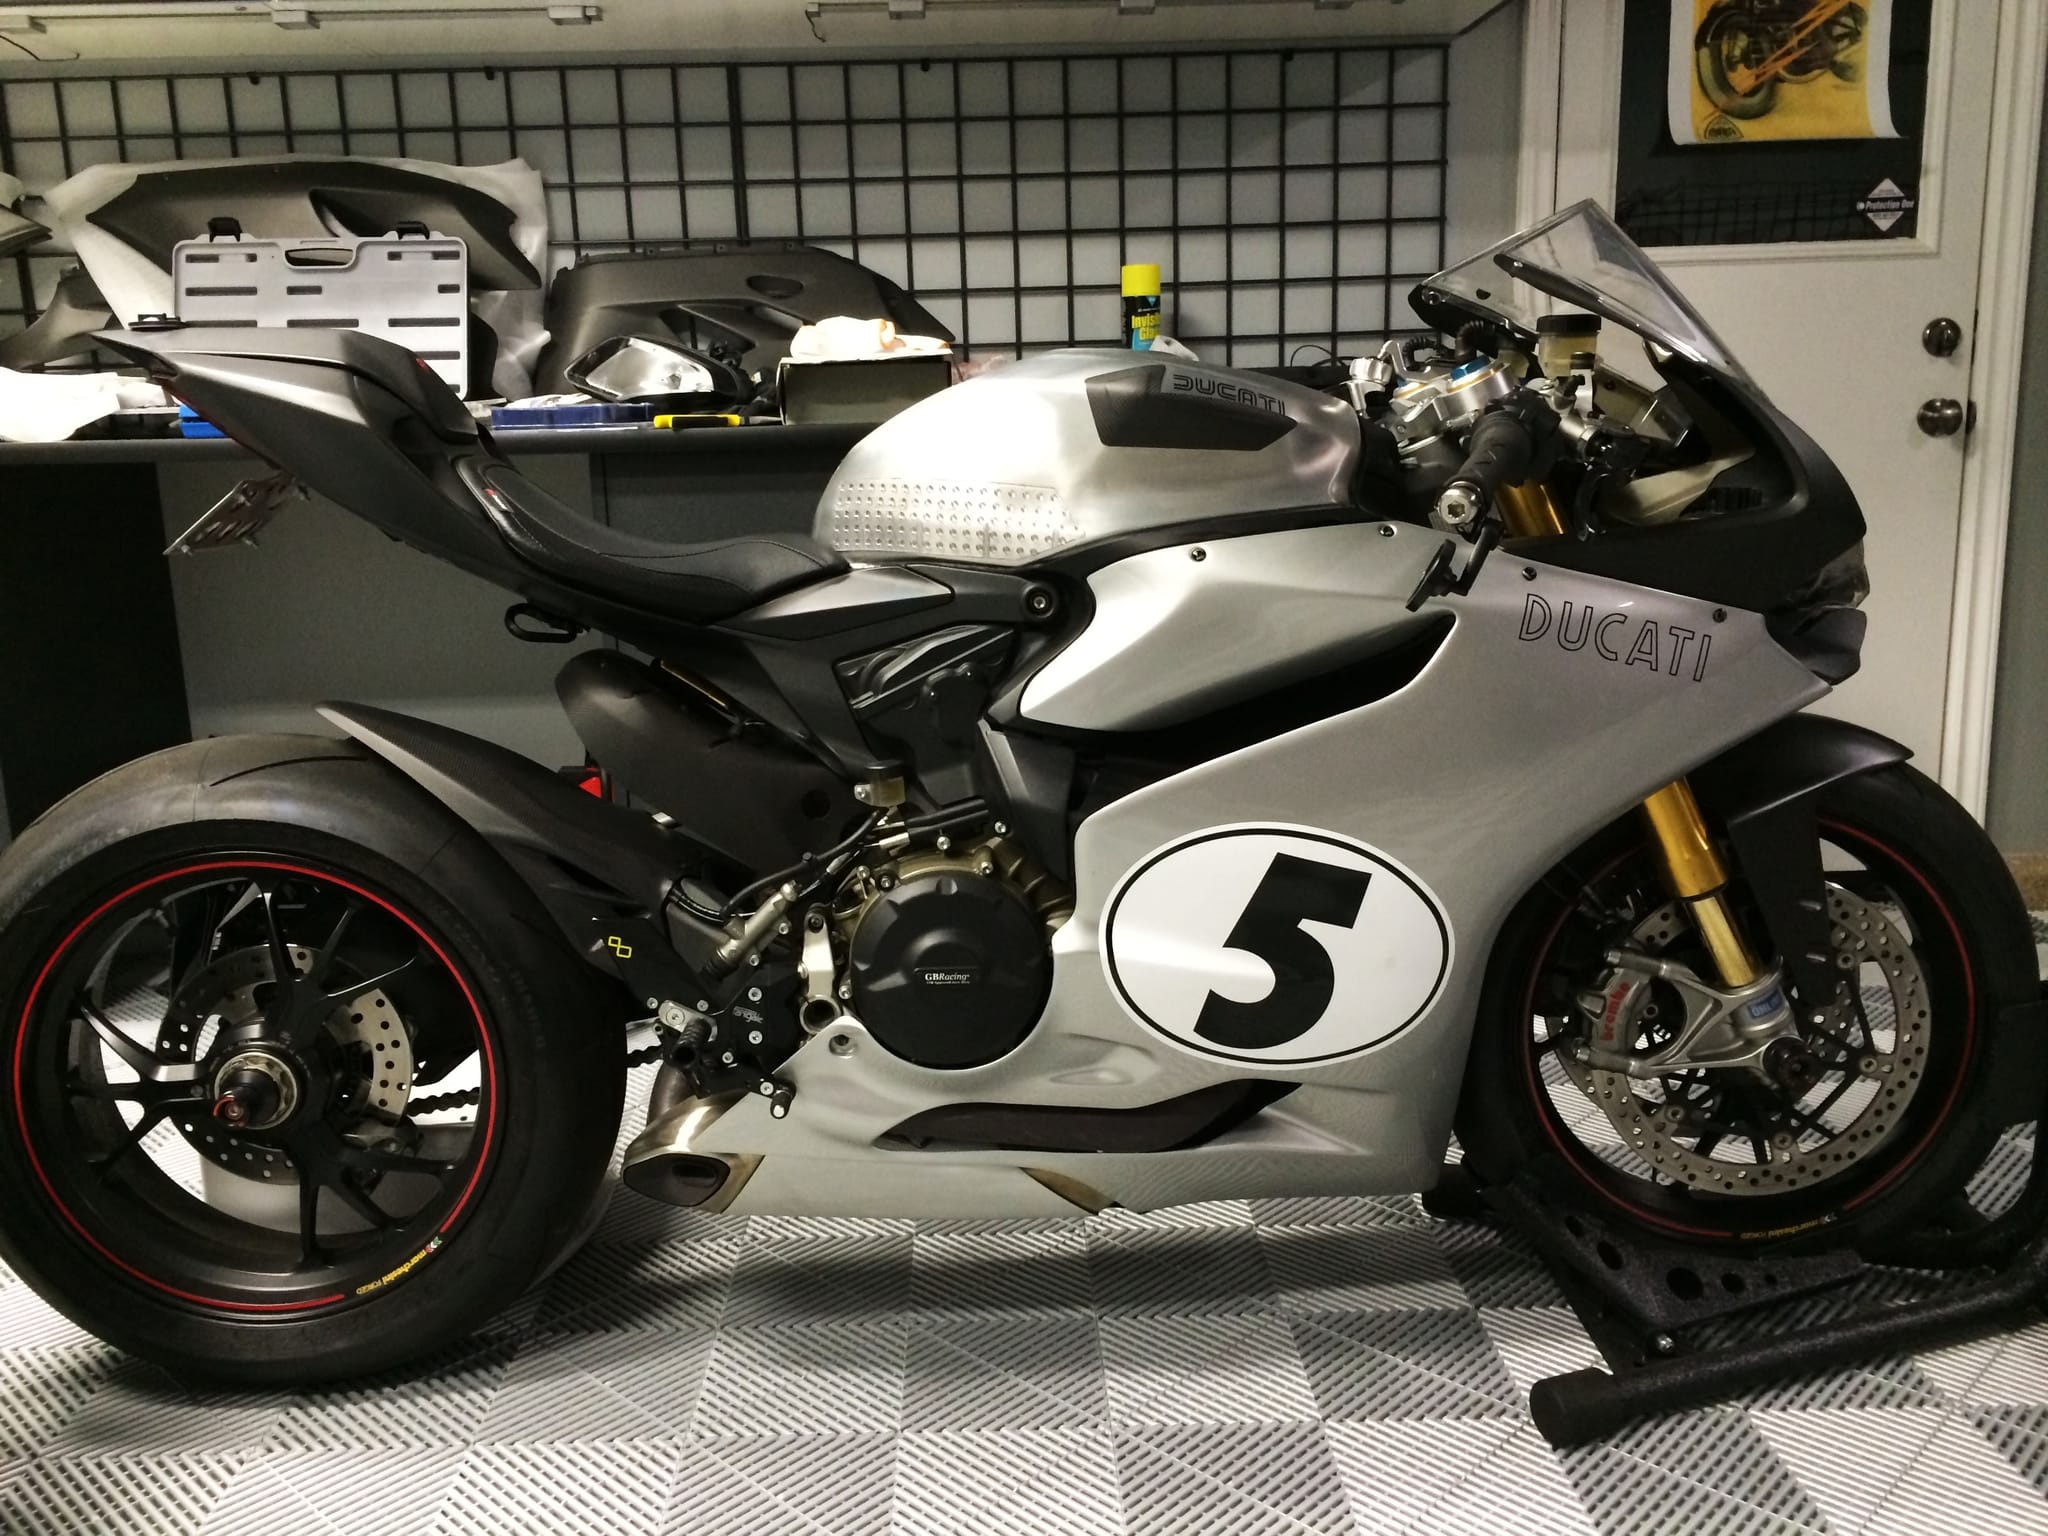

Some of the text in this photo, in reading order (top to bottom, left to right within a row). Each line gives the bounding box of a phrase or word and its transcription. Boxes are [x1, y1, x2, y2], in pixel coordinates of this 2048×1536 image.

[1173, 374, 1286, 416] DUCATI
[1519, 593, 1712, 682] DUCATI
[1193, 852, 1372, 1050] 5
[1601, 981, 1631, 1041] brembo
